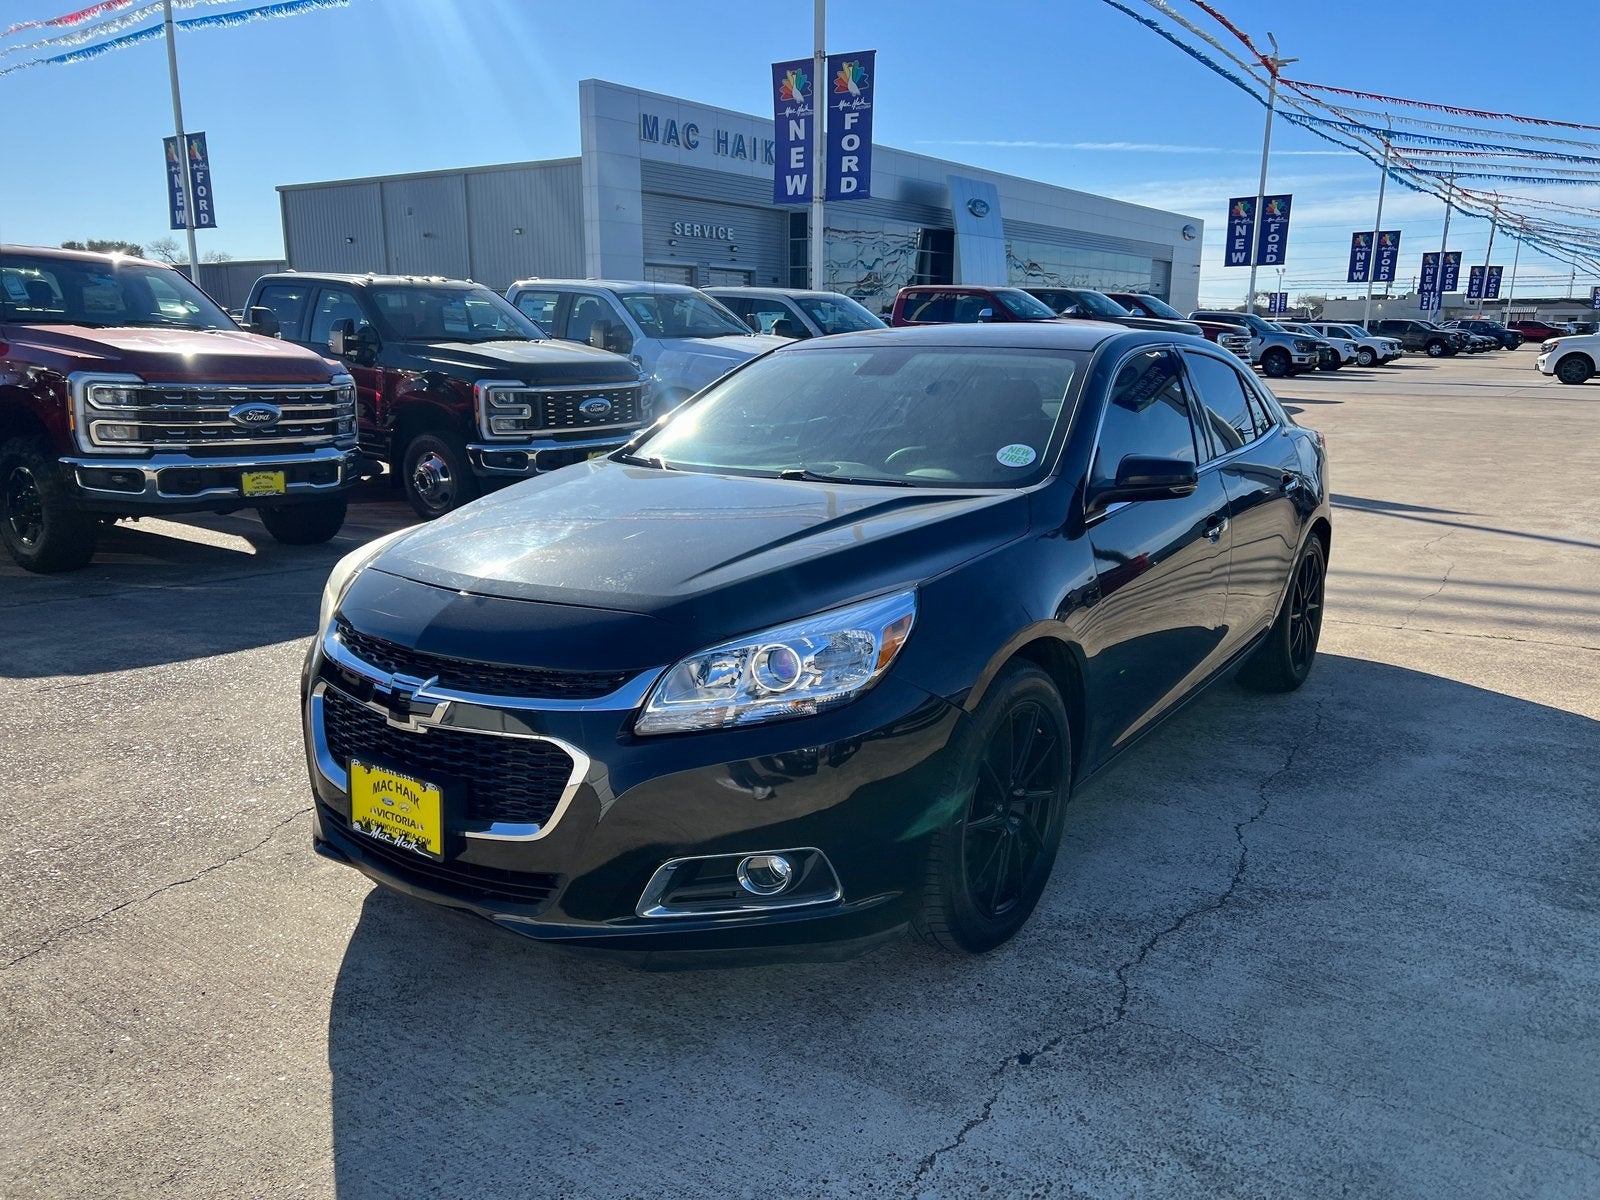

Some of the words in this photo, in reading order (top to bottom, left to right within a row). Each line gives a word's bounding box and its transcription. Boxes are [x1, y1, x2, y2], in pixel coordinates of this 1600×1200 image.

[640, 113, 699, 151] MAC
[714, 129, 775, 164] HAIK
[785, 118, 808, 196] NEW
[840, 112, 861, 194] FORD
[196, 172, 209, 225] FORD
[674, 221, 735, 240] SERVICE
[1231, 225, 1247, 263] NEW
[1265, 223, 1280, 263] FORD
[1353, 252, 1366, 280] NEW
[1380, 251, 1391, 280] FORD
[1423, 268, 1434, 290] NEW
[1444, 267, 1454, 290] FORD
[1470, 278, 1480, 297] NEW
[246, 410, 270, 421] Ford
[590, 403, 606, 412] Ford
[999, 452, 1030, 465] TIRES
[1007, 446, 1033, 456] NEW
[372, 780, 394, 795] MAC
[395, 781, 420, 810] HAIK
[377, 807, 417, 830] VICTORIA
[365, 826, 393, 843] Mac
